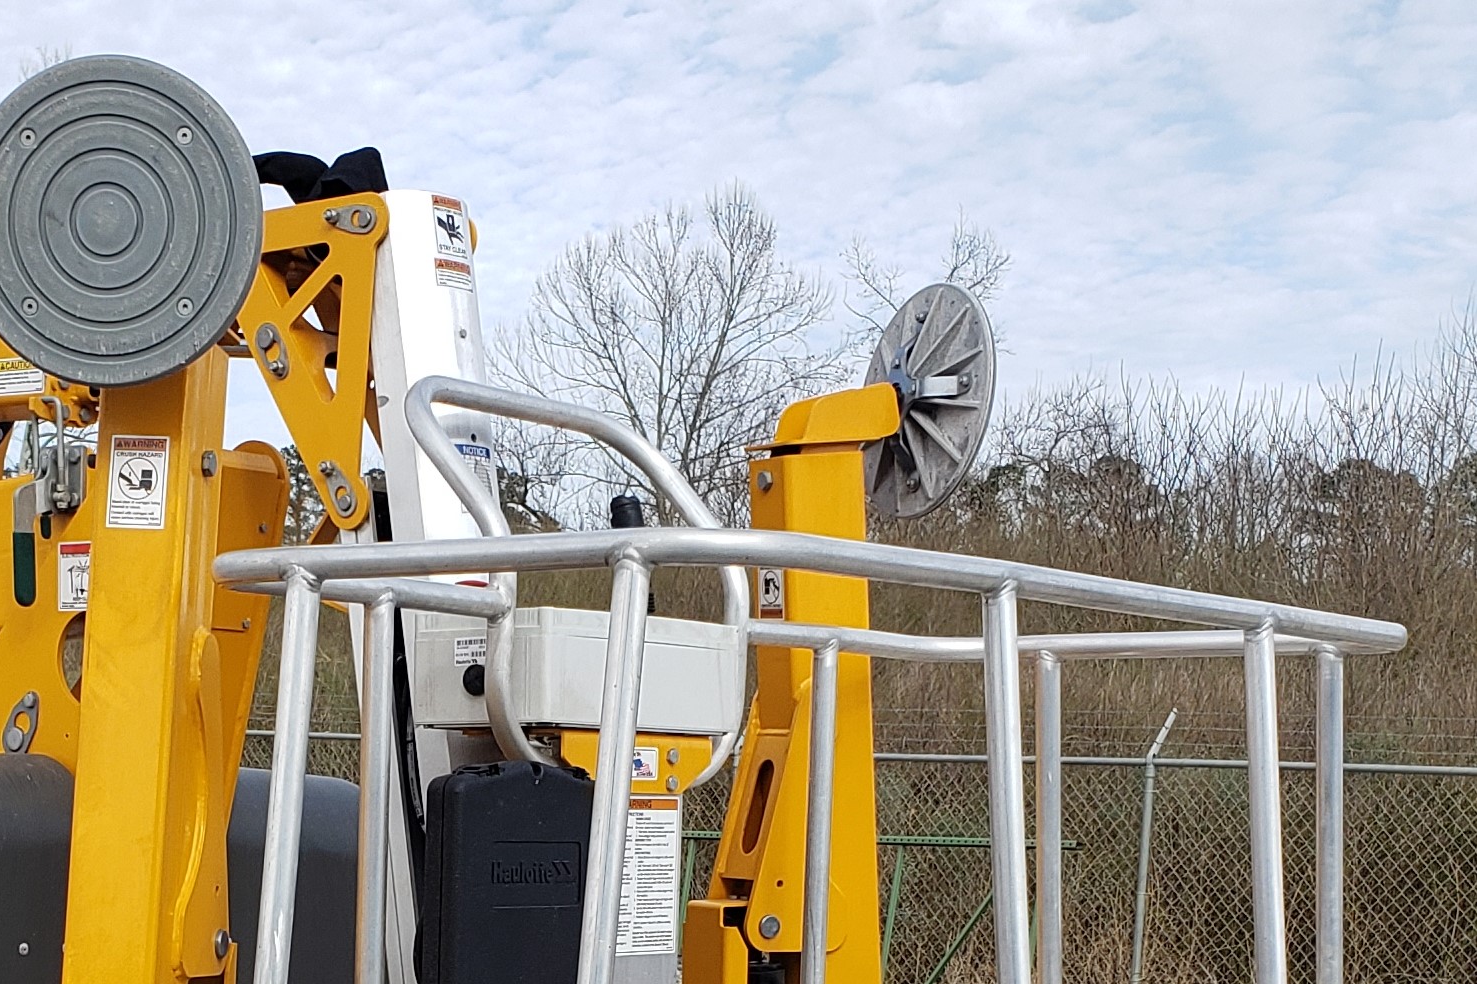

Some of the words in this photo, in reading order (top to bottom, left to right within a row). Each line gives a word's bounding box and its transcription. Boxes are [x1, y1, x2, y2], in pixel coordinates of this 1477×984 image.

[124, 440, 164, 449] WARNING
[463, 446, 487, 457] NOTICE
[491, 861, 553, 885] Haulotte
